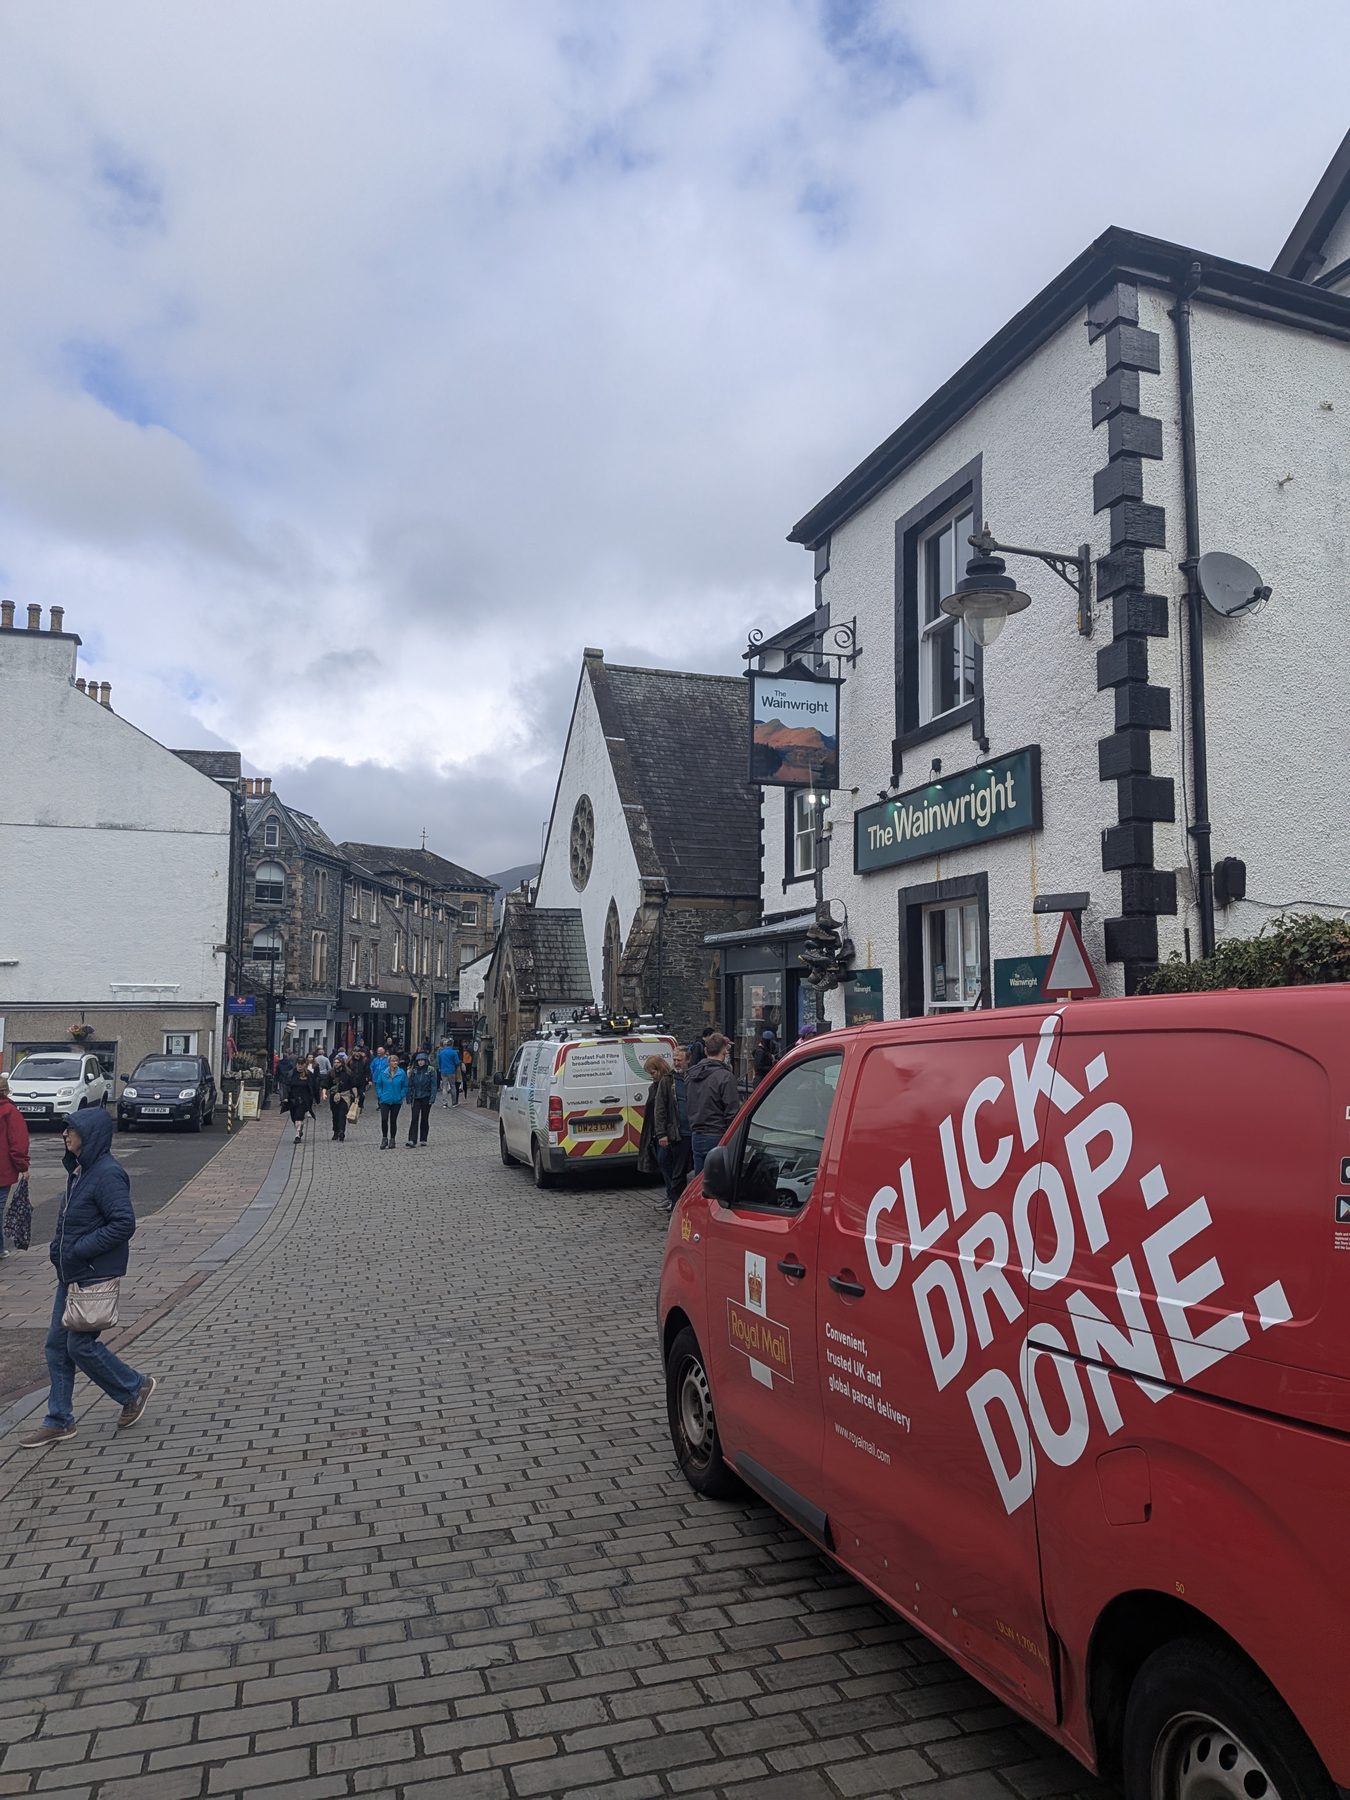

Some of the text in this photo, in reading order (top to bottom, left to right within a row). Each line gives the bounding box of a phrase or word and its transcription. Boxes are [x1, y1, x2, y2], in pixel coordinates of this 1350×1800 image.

[761, 695, 829, 714] Wainwright
[774, 689, 787, 697] The
[867, 770, 1016, 850] The Wainwright
[370, 998, 387, 1009] Rohan
[1009, 977, 1038, 988] Wainwright
[864, 1006, 1109, 1291] CLICK.
[912, 1102, 1169, 1392] DROP.
[730, 1309, 787, 1365] Royal Mail
[825, 1322, 868, 1357] Convenient,
[966, 1196, 1294, 1516] DONE.
[826, 1348, 882, 1388] trusted UK and
[828, 1373, 911, 1433] global parcel delivery
[834, 1421, 891, 1465] www.royalmail.com
[1175, 1581, 1185, 1594] 50
